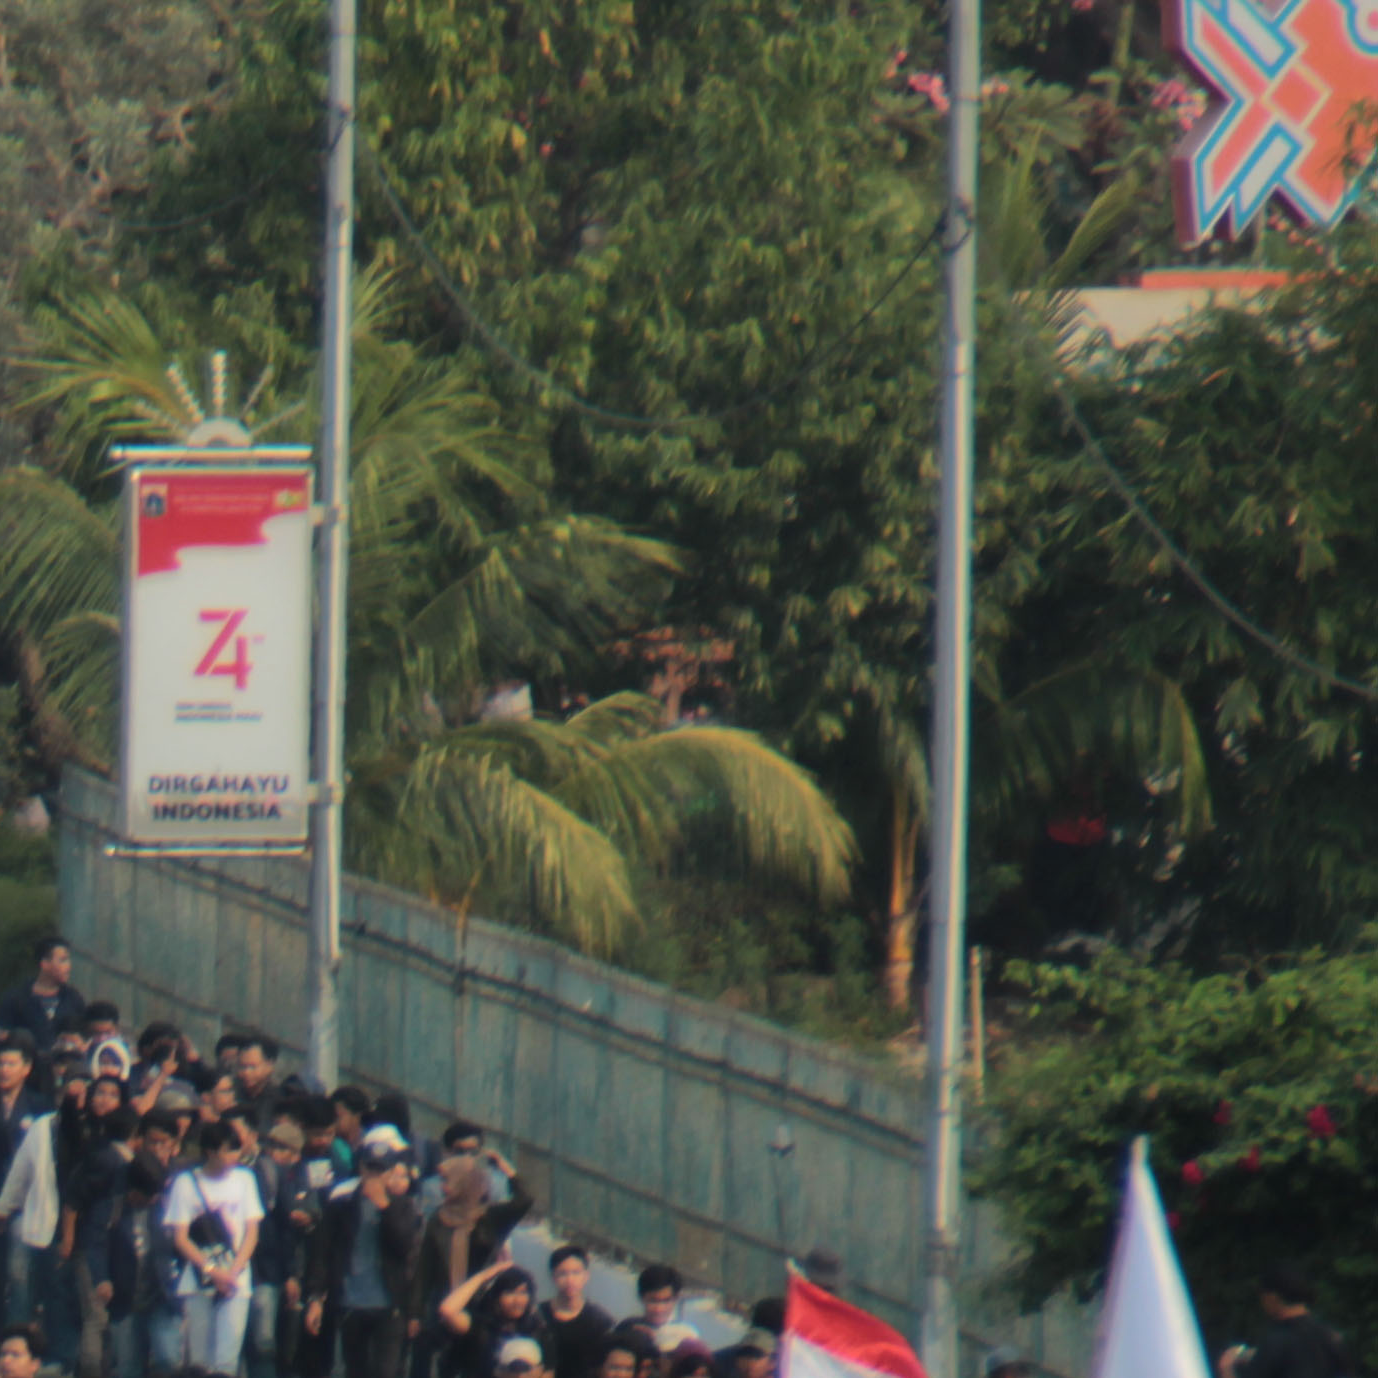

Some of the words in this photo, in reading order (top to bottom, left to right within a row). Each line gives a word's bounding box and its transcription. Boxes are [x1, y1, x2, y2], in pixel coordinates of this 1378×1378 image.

[194, 609, 252, 690] 74
[148, 774, 288, 795] DIRGAHAYU
[151, 803, 283, 823] INDONESIA
